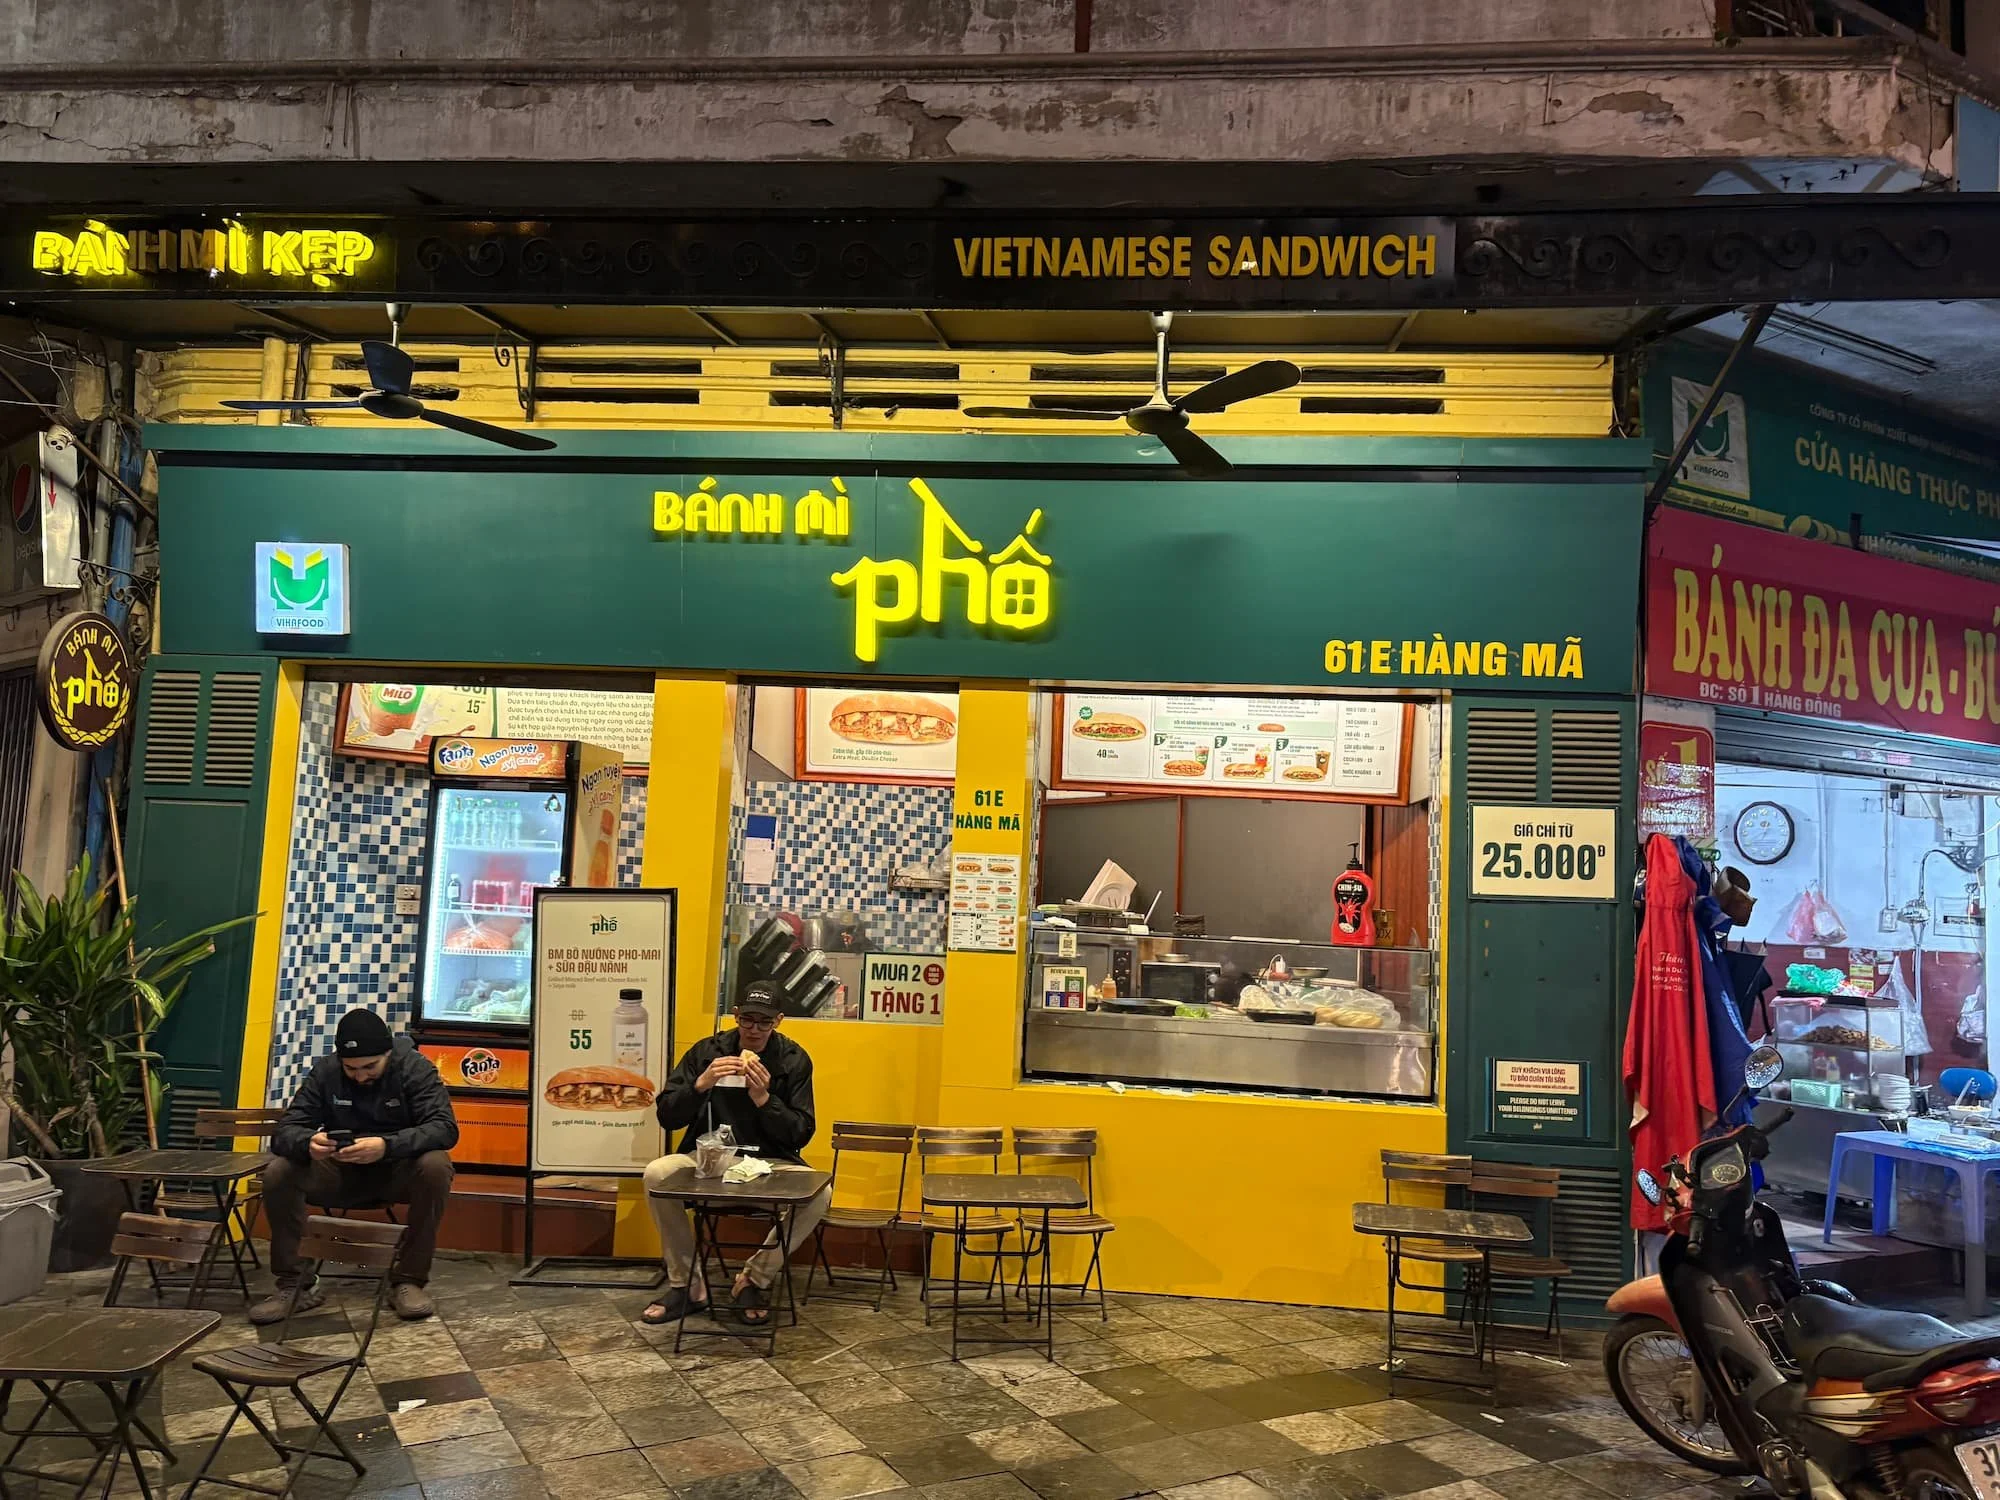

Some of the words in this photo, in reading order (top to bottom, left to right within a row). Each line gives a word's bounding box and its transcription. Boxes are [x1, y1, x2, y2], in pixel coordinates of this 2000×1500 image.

[954, 235, 1192, 278] VIETNAMESE
[1207, 234, 1435, 278] SANDWICH
[1794, 430, 1843, 477] CỬA
[1849, 451, 1912, 495] HÀNG
[1917, 471, 1970, 516] THỰC
[653, 476, 783, 533] BÁNH
[795, 476, 849, 535] MÌ
[830, 477, 1053, 662] phố
[276, 618, 324, 628] VIHAFOOD
[1673, 543, 1792, 690] BÁNH
[1802, 595, 1859, 701] ĐA
[1868, 609, 1944, 715] CUA
[65, 628, 98, 657] BÁNH
[1324, 639, 1391, 674] 61E
[1400, 633, 1507, 677] HÀNG
[1521, 636, 1584, 679] MÃ
[62, 648, 121, 720] phố
[383, 688, 413, 700] MILO
[1699, 680, 1725, 702] ĐC:
[1728, 680, 1748, 703] SỐ
[1750, 685, 1762, 706] 1
[1764, 688, 1802, 711] HÀNG
[467, 699, 480, 714] 15
[438, 745, 474, 765] Fanta
[479, 750, 508, 769] Ngon
[511, 743, 537, 755] tuyệt
[581, 772, 601, 795] Ngon
[975, 790, 1004, 807] 61E
[956, 812, 992, 830] HÀNG
[998, 813, 1020, 831] MÃ
[1514, 822, 1533, 838] GIÁ
[1558, 821, 1574, 838] TỪ
[1337, 884, 1363, 892] CHIN-SU
[589, 914, 617, 935] phố
[548, 949, 564, 960] BM
[618, 949, 661, 961] PHO-MAI
[555, 960, 575, 973] SỮA
[578, 960, 597, 975] ĐẬU
[599, 961, 628, 973] NÀNH
[871, 963, 908, 981] MUA
[912, 964, 921, 982] 2
[871, 986, 924, 1018] TẶNG
[930, 993, 941, 1015] 1
[570, 1030, 592, 1050] 55
[461, 1056, 500, 1077] Fanta
